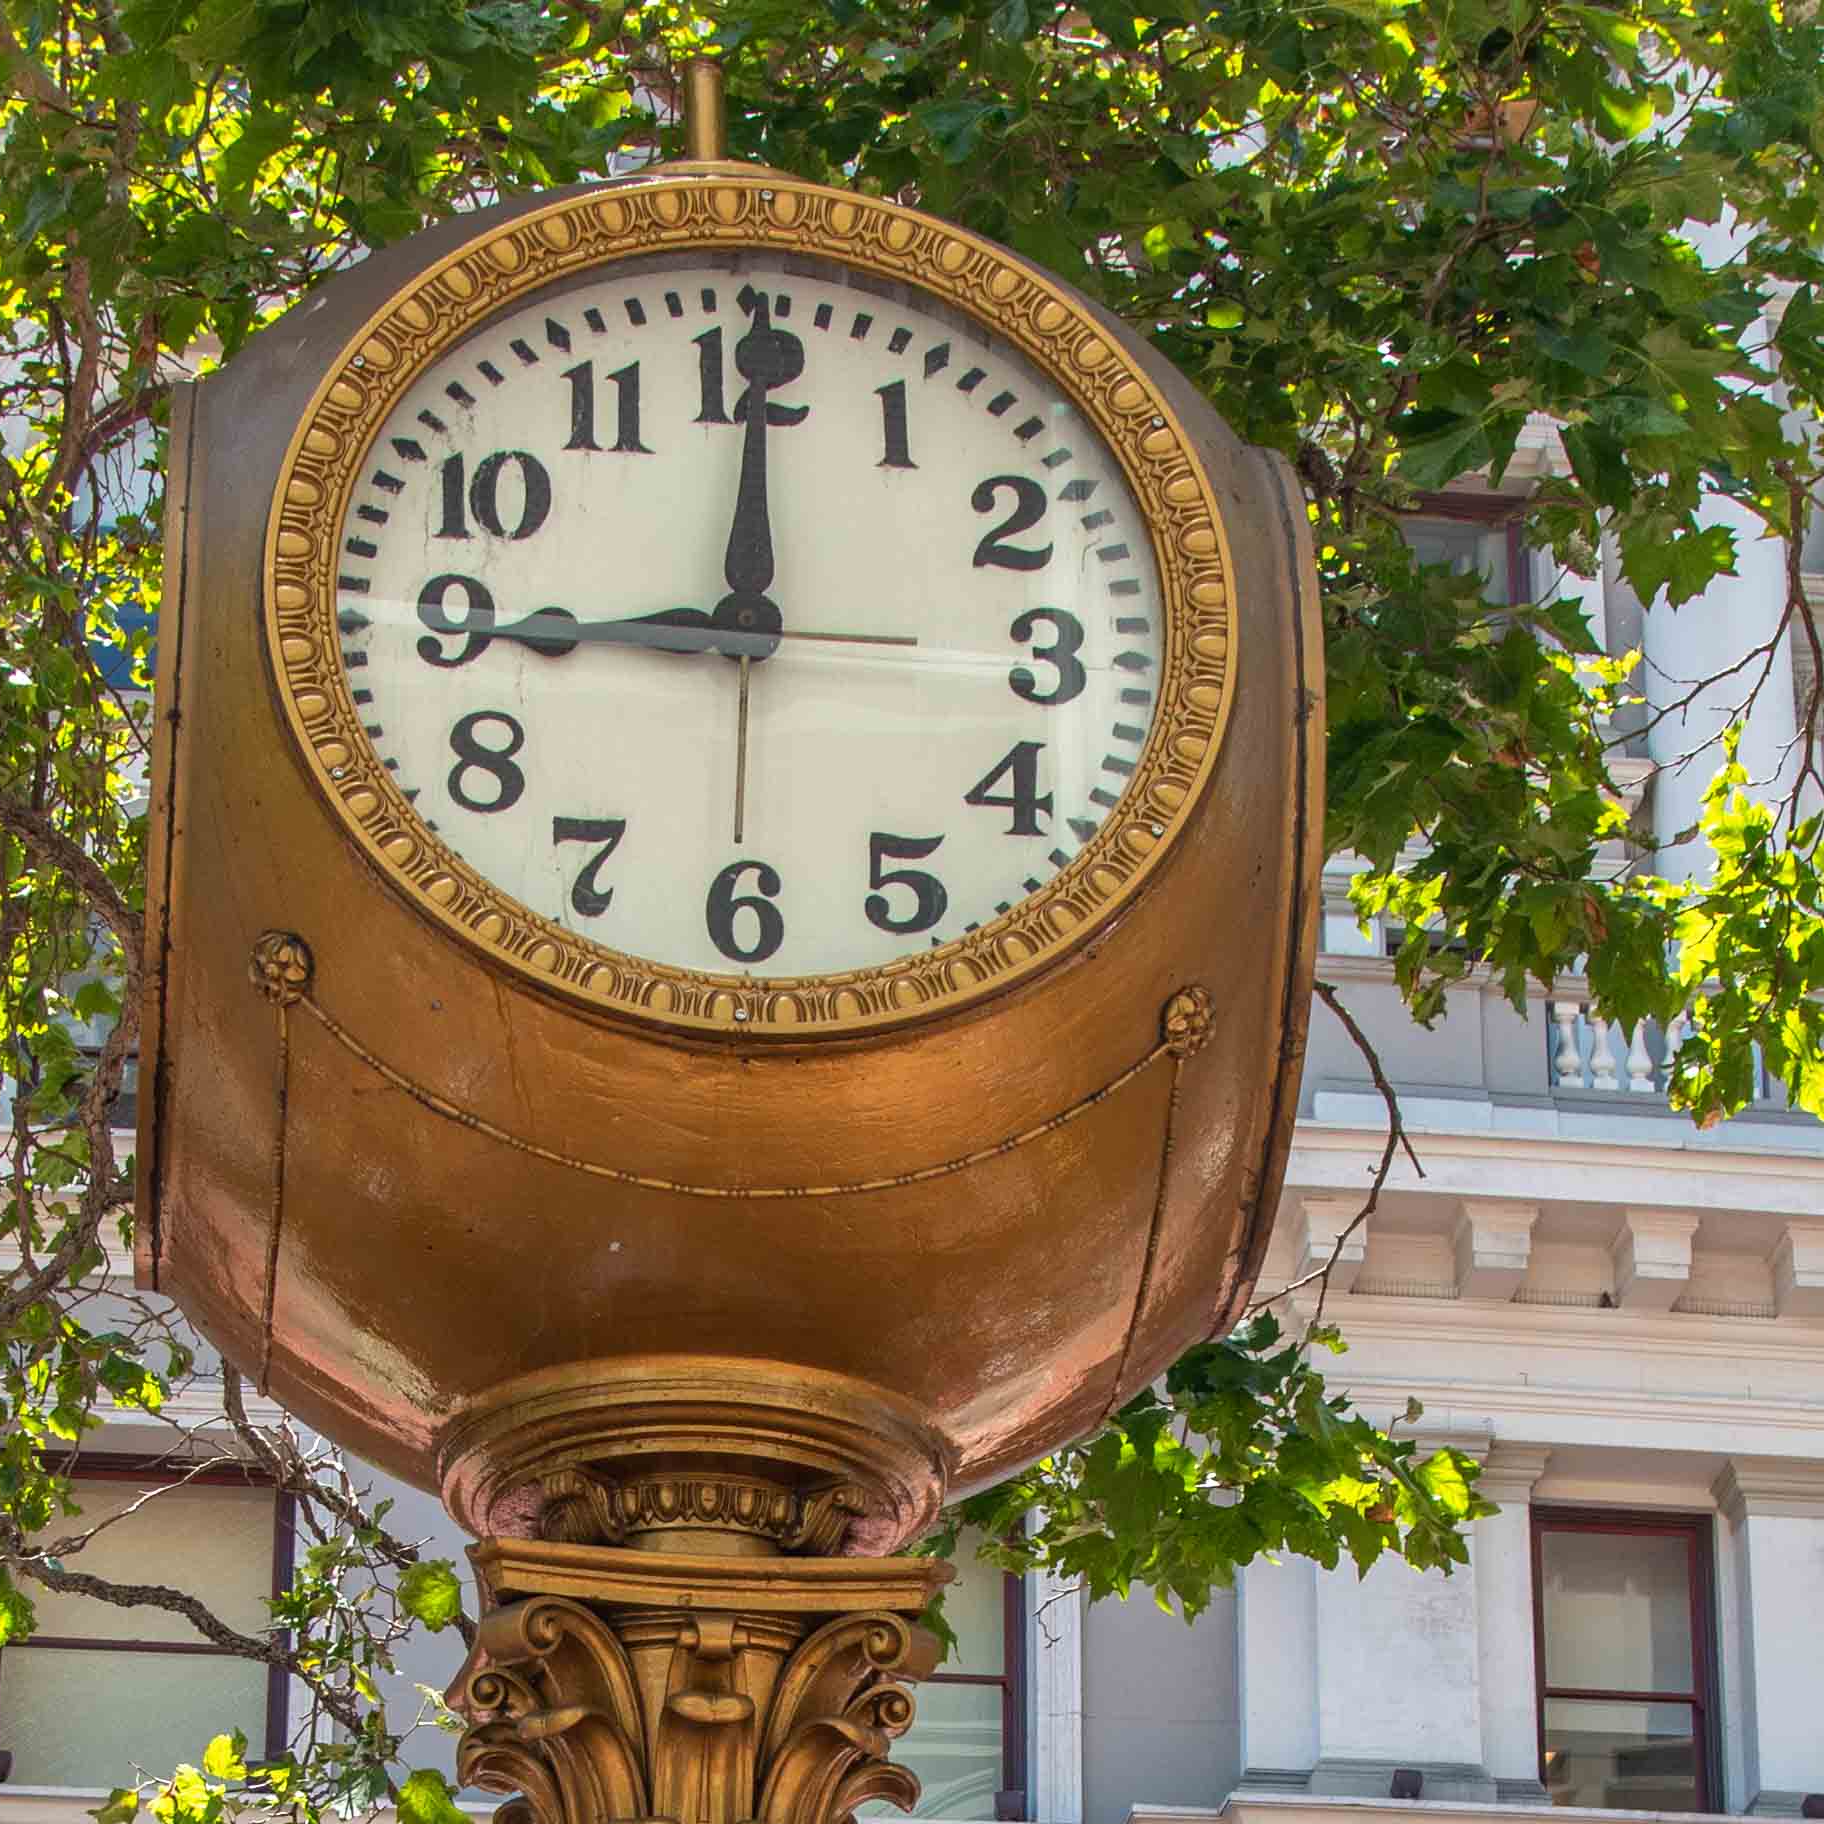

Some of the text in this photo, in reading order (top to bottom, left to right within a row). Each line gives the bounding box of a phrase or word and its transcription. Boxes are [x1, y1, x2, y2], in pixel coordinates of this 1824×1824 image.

[559, 360, 653, 454] 11
[690, 324, 811, 427] 12
[874, 379, 919, 469] 1
[434, 450, 552, 541] 10
[971, 475, 1054, 572] 2
[416, 573, 495, 669] 9
[1007, 608, 1087, 707] 3
[447, 710, 526, 814] 8
[964, 740, 1054, 837] 4
[552, 815, 627, 918] 7
[706, 860, 785, 963] 6
[864, 831, 948, 935] 5
